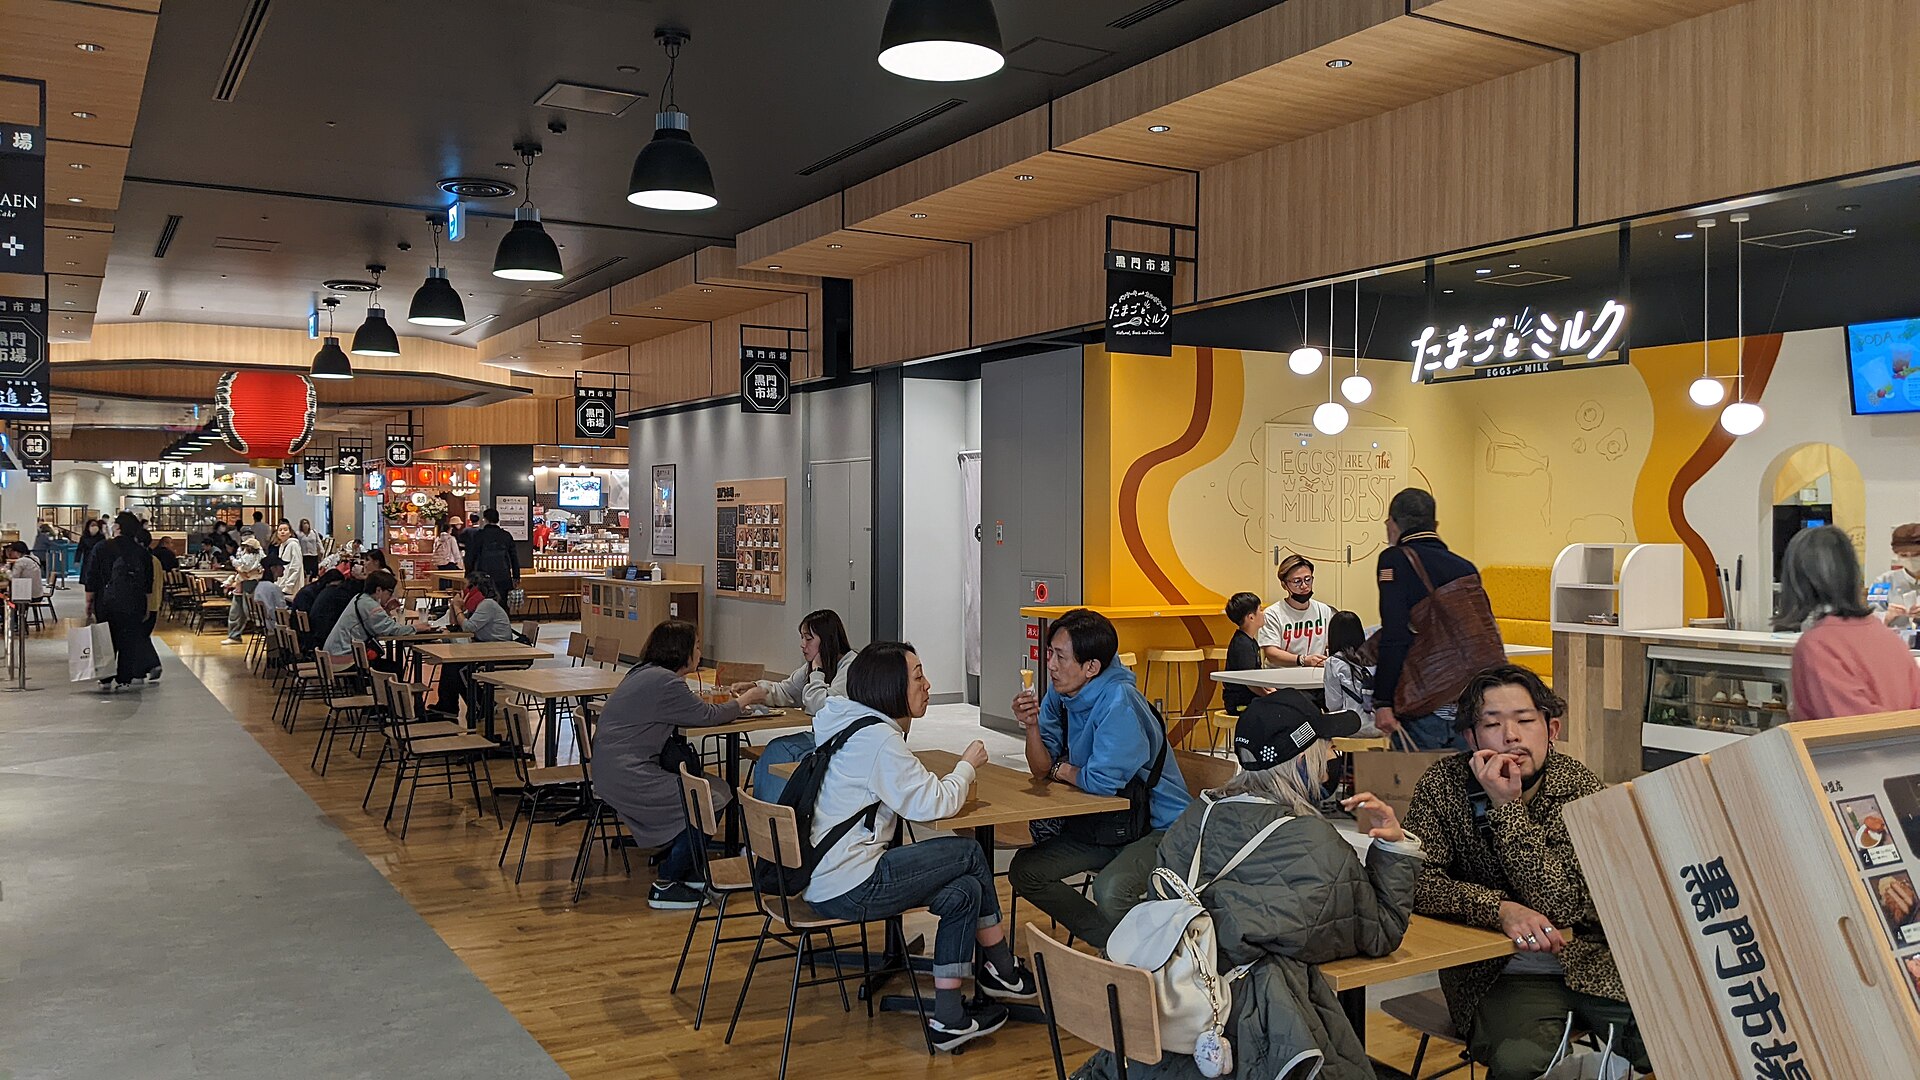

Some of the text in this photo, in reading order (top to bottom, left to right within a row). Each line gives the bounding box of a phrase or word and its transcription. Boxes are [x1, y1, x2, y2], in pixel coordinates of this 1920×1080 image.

[0, 132, 33, 151] 場
[1115, 255, 1170, 273] 黒門市場
[1109, 302, 1170, 329] たまごとミルク
[1411, 299, 1626, 384] たまごとミルク
[746, 349, 788, 360] 黒門市場
[1486, 366, 1511, 378] EGGS
[1524, 362, 1549, 373] MILK
[754, 374, 778, 387] 黒門
[754, 386, 779, 400] 市場
[585, 408, 605, 418] 黒門
[585, 417, 605, 428] 市場
[1280, 450, 1392, 475] EGGS ARE The
[127, 465, 203, 479] 黒門市場
[1281, 493, 1336, 523] MILK
[1341, 474, 1397, 523] BEST
[1027, 627, 1039, 637] 消火
[1862, 853, 1870, 863] 2
[1679, 855, 1813, 1080] 黒門市場
